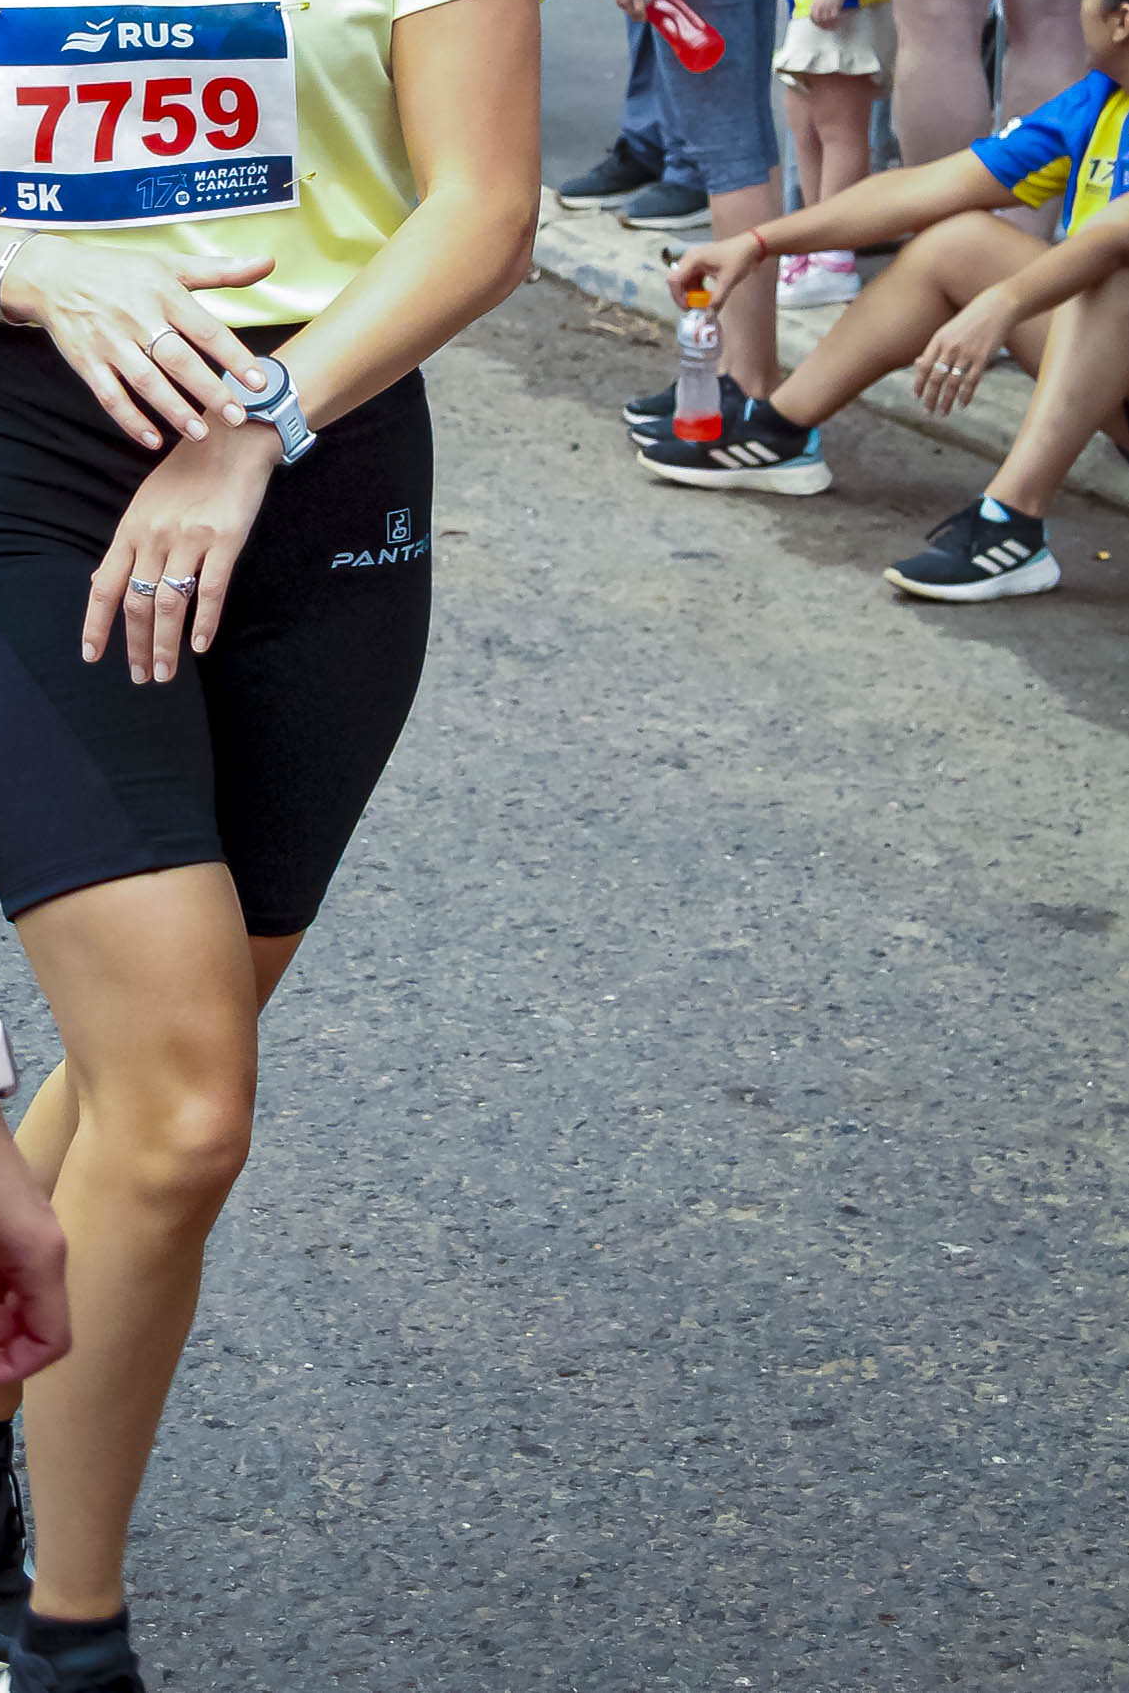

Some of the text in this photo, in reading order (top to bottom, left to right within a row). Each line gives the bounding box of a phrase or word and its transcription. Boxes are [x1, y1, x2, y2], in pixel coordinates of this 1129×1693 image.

[117, 21, 195, 49] RUS
[16, 76, 260, 164] 7759
[194, 162, 269, 181] MARATÓN
[196, 175, 268, 192] CANALLA
[17, 182, 64, 212] 5K
[136, 171, 185, 210] 17
